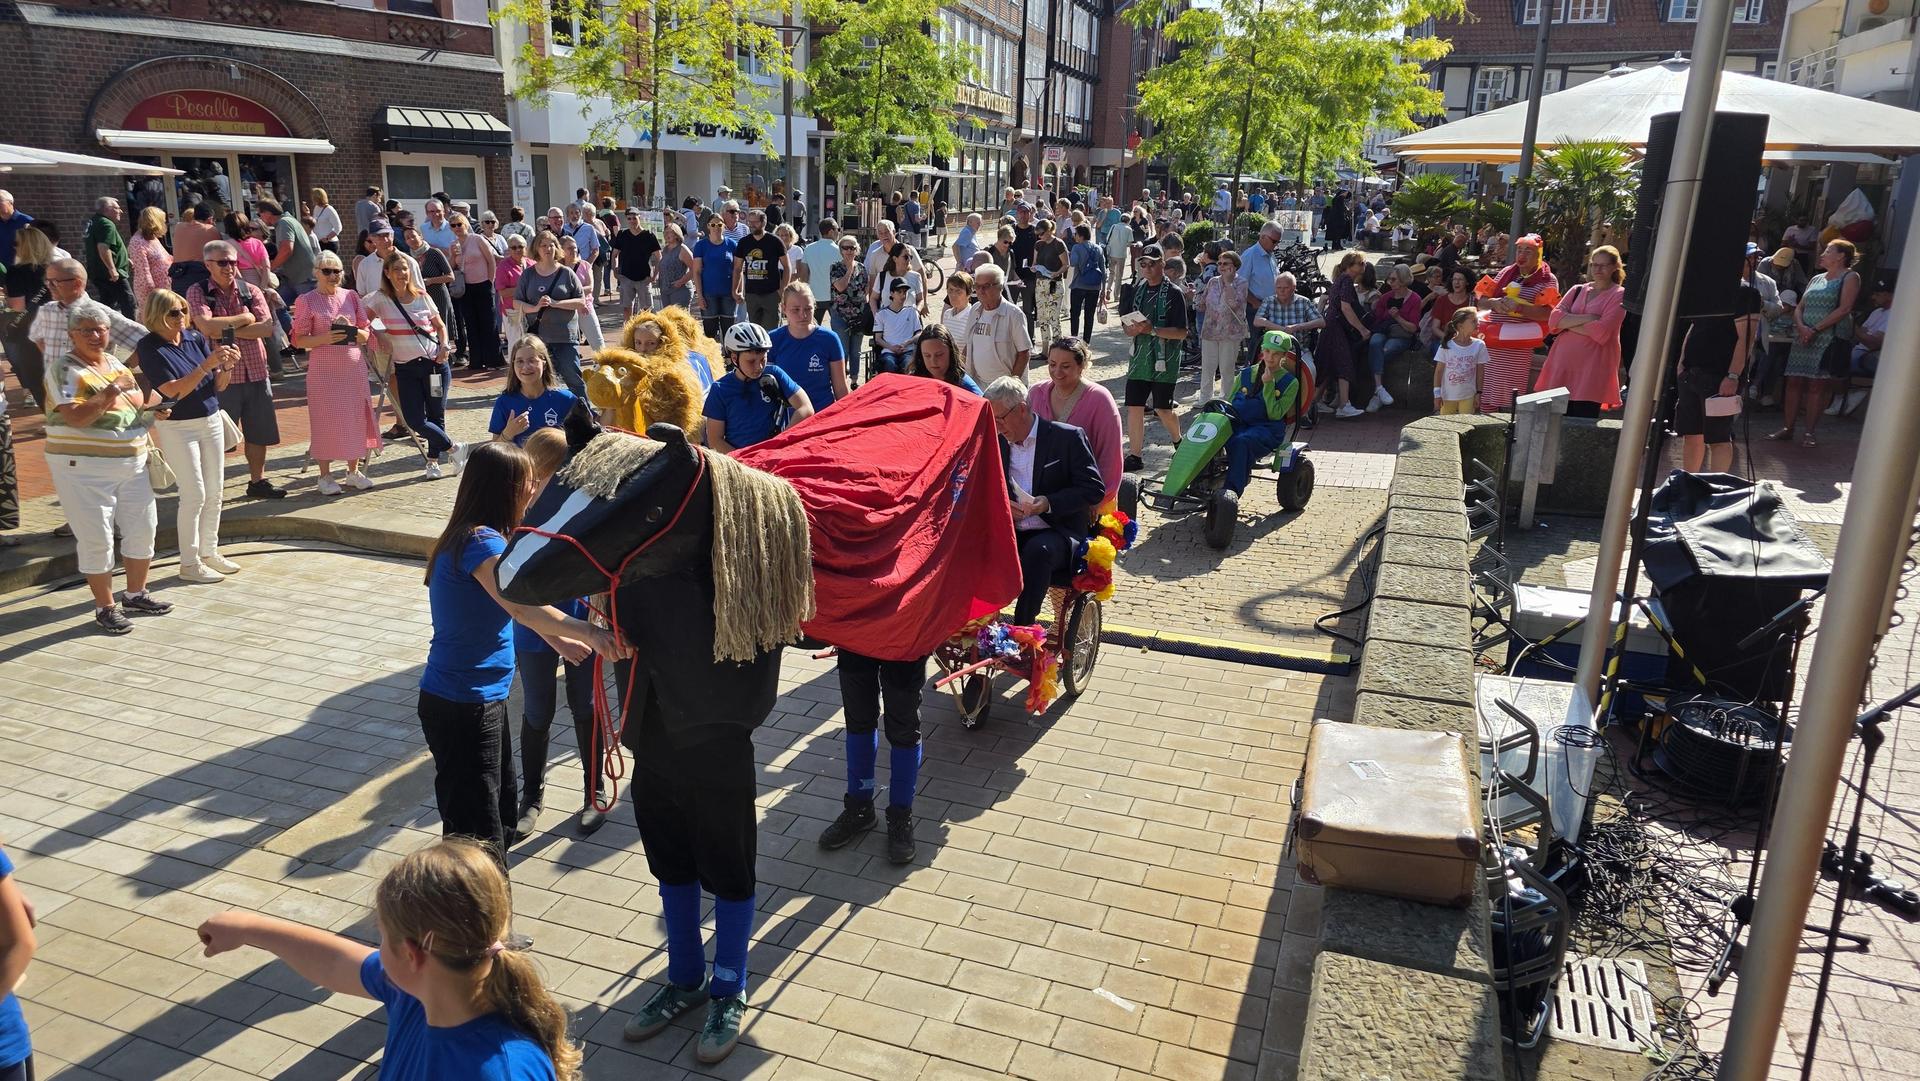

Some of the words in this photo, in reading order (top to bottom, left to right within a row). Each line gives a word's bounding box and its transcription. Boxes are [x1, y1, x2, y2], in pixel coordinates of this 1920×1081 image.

[166, 93, 240, 119] Pesalla
[978, 90, 1012, 114] APOTHEKE
[746, 259, 769, 270] ZEIT
[1273, 335, 1280, 345] L
[1192, 424, 1209, 440] L
